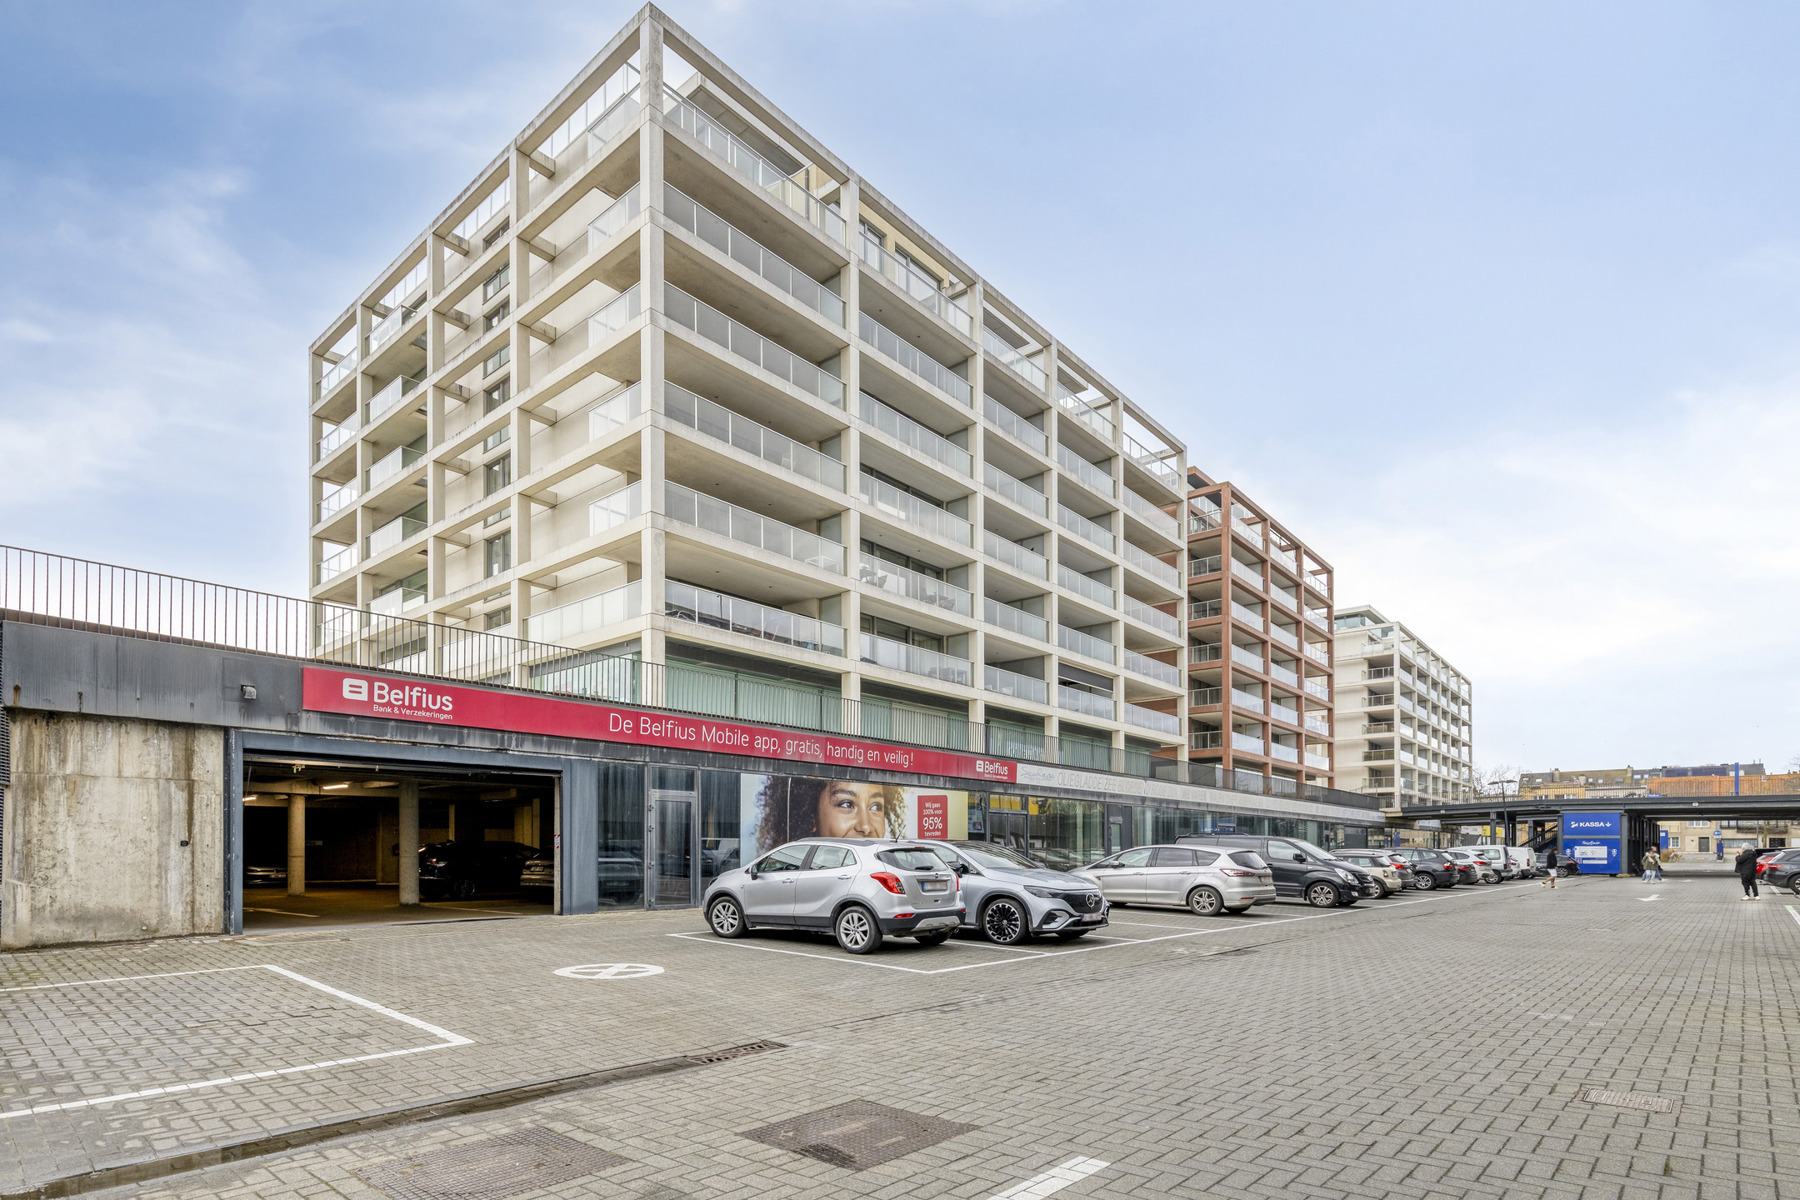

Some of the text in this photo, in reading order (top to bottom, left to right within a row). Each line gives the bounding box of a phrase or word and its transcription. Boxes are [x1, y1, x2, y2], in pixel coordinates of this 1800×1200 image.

[373, 681, 453, 711] Belfius
[373, 704, 453, 720] Bank & Verzekeringen
[609, 713, 633, 734] De
[640, 716, 696, 741] Belfius
[702, 725, 750, 747] Mobile
[754, 735, 781, 754] app,
[785, 739, 823, 759] gratis,
[826, 742, 864, 764] handig
[867, 750, 880, 762] en
[984, 760, 1009, 775] Belfius
[922, 816, 943, 830] 95%
